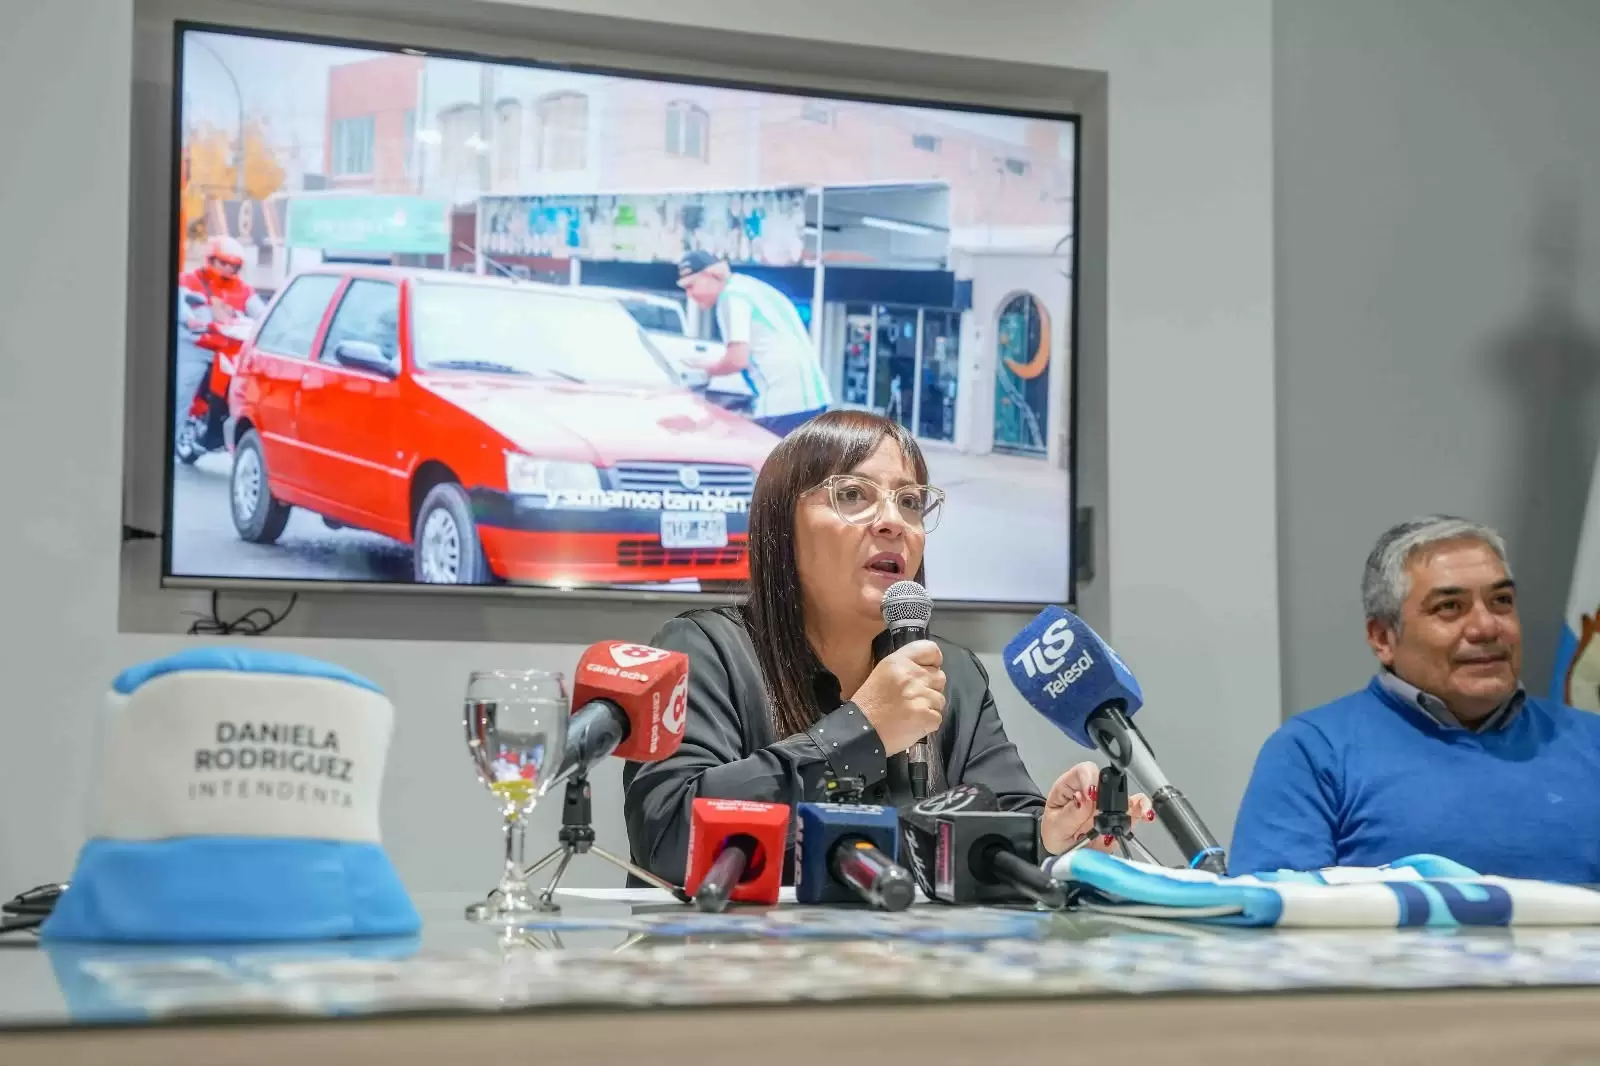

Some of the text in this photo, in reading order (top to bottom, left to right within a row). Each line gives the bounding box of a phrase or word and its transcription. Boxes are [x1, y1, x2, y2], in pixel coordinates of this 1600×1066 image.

[544, 489, 557, 510] y
[558, 490, 662, 508] sumamos
[1012, 617, 1075, 678] TLS
[586, 663, 618, 677] canal
[1042, 649, 1094, 699] Telesol
[216, 721, 339, 751] DANIELA
[194, 749, 353, 782] RODRIGUEZ
[188, 779, 352, 808] INTENDENTA
